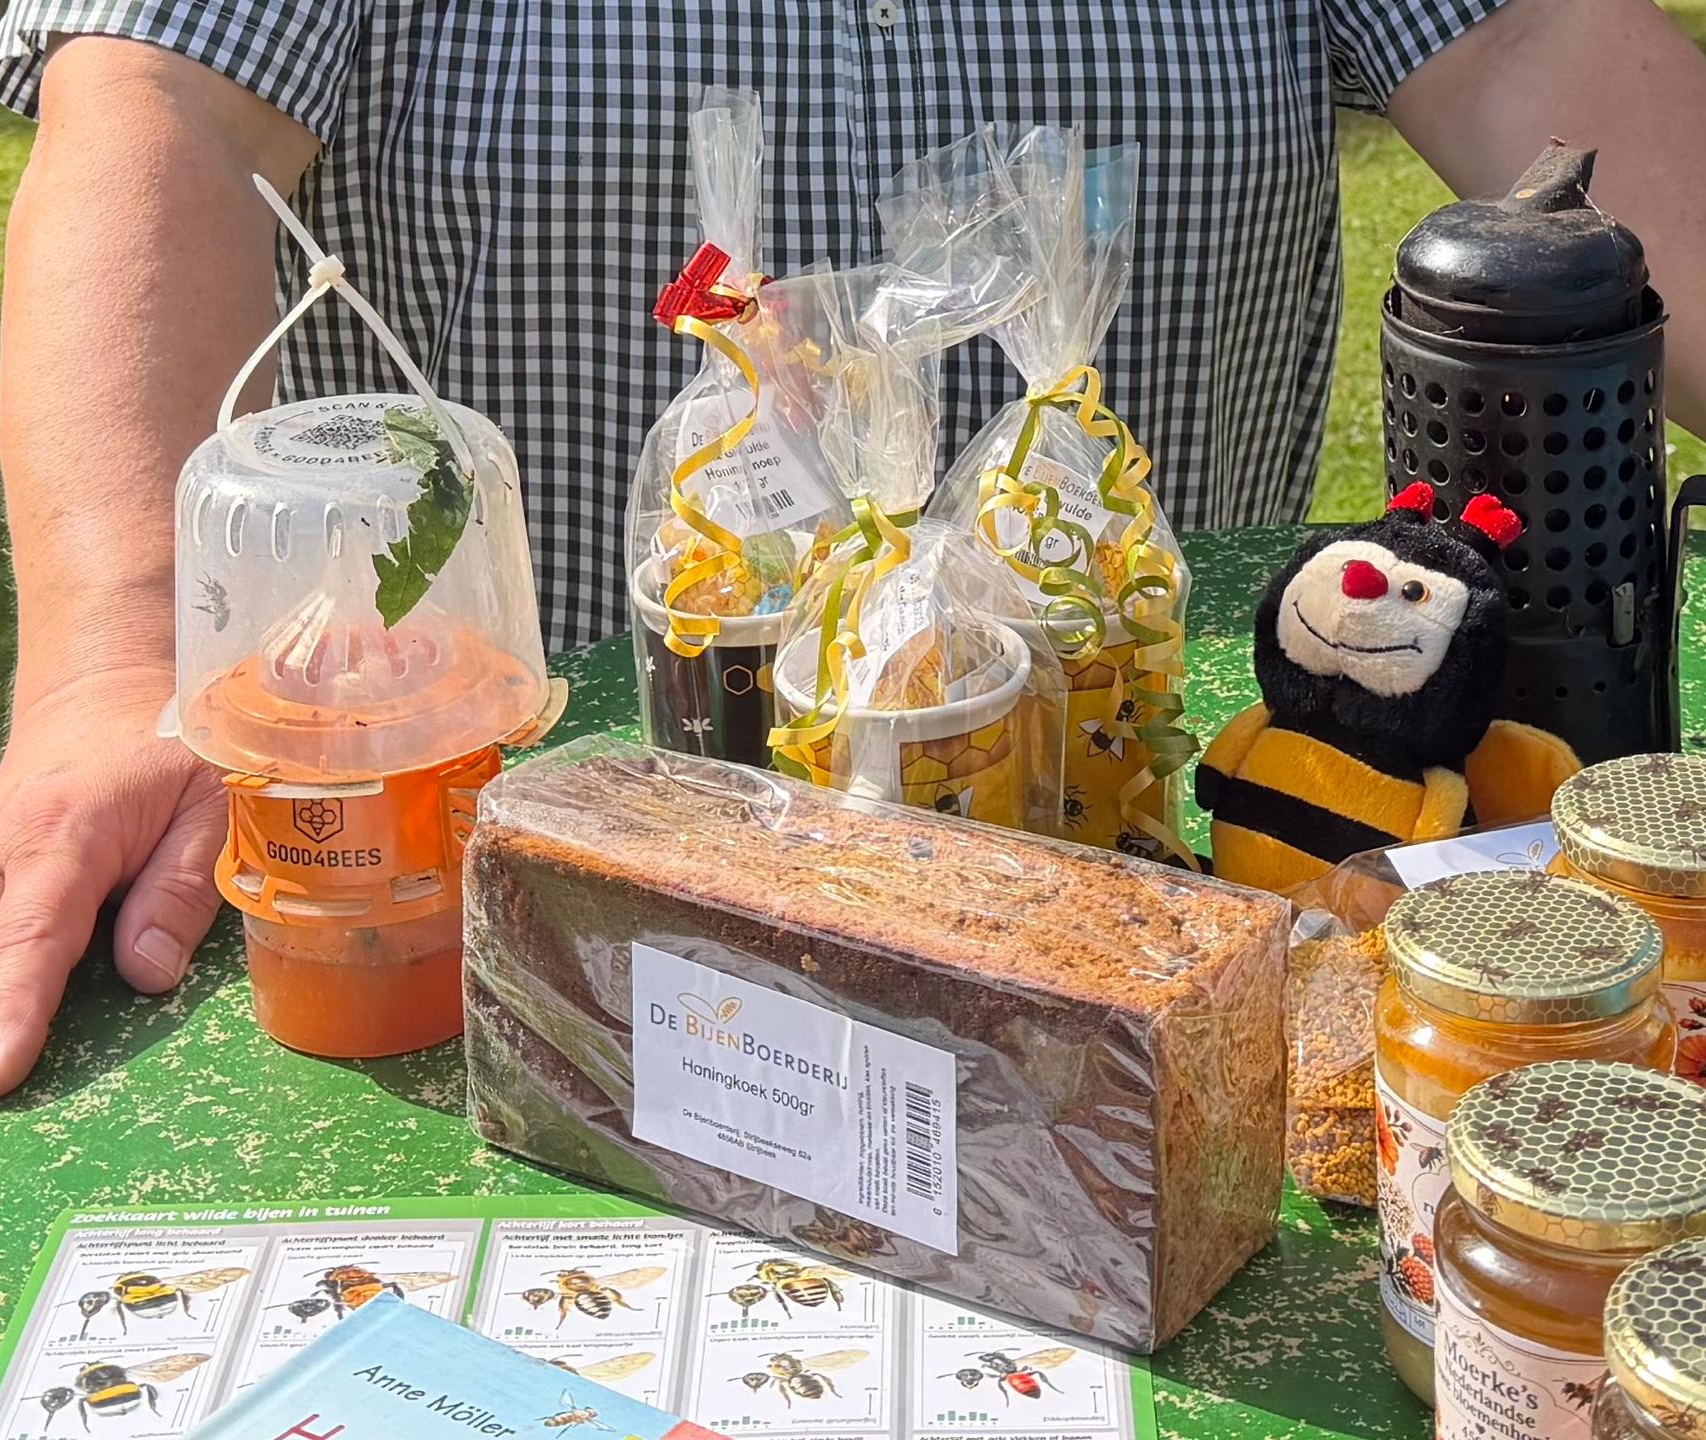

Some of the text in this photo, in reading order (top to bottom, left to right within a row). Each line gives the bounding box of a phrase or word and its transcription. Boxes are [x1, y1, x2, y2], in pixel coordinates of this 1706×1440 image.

[318, 402, 370, 413] SCAN
[266, 840, 382, 868] GOOD4BEES
[682, 1056, 815, 1116] Honingkoek 500gr
[70, 1205, 391, 1224] Zoekkaart wilde bijen in tuinen
[497, 1220, 644, 1230] Achterlijf kort behaard
[73, 1228, 221, 1239] Achterlijf lang behaard
[1444, 1329, 1539, 1410] Moerke's
[353, 1365, 517, 1440] Anne Möller
[1445, 1355, 1536, 1429] Nederlandse
